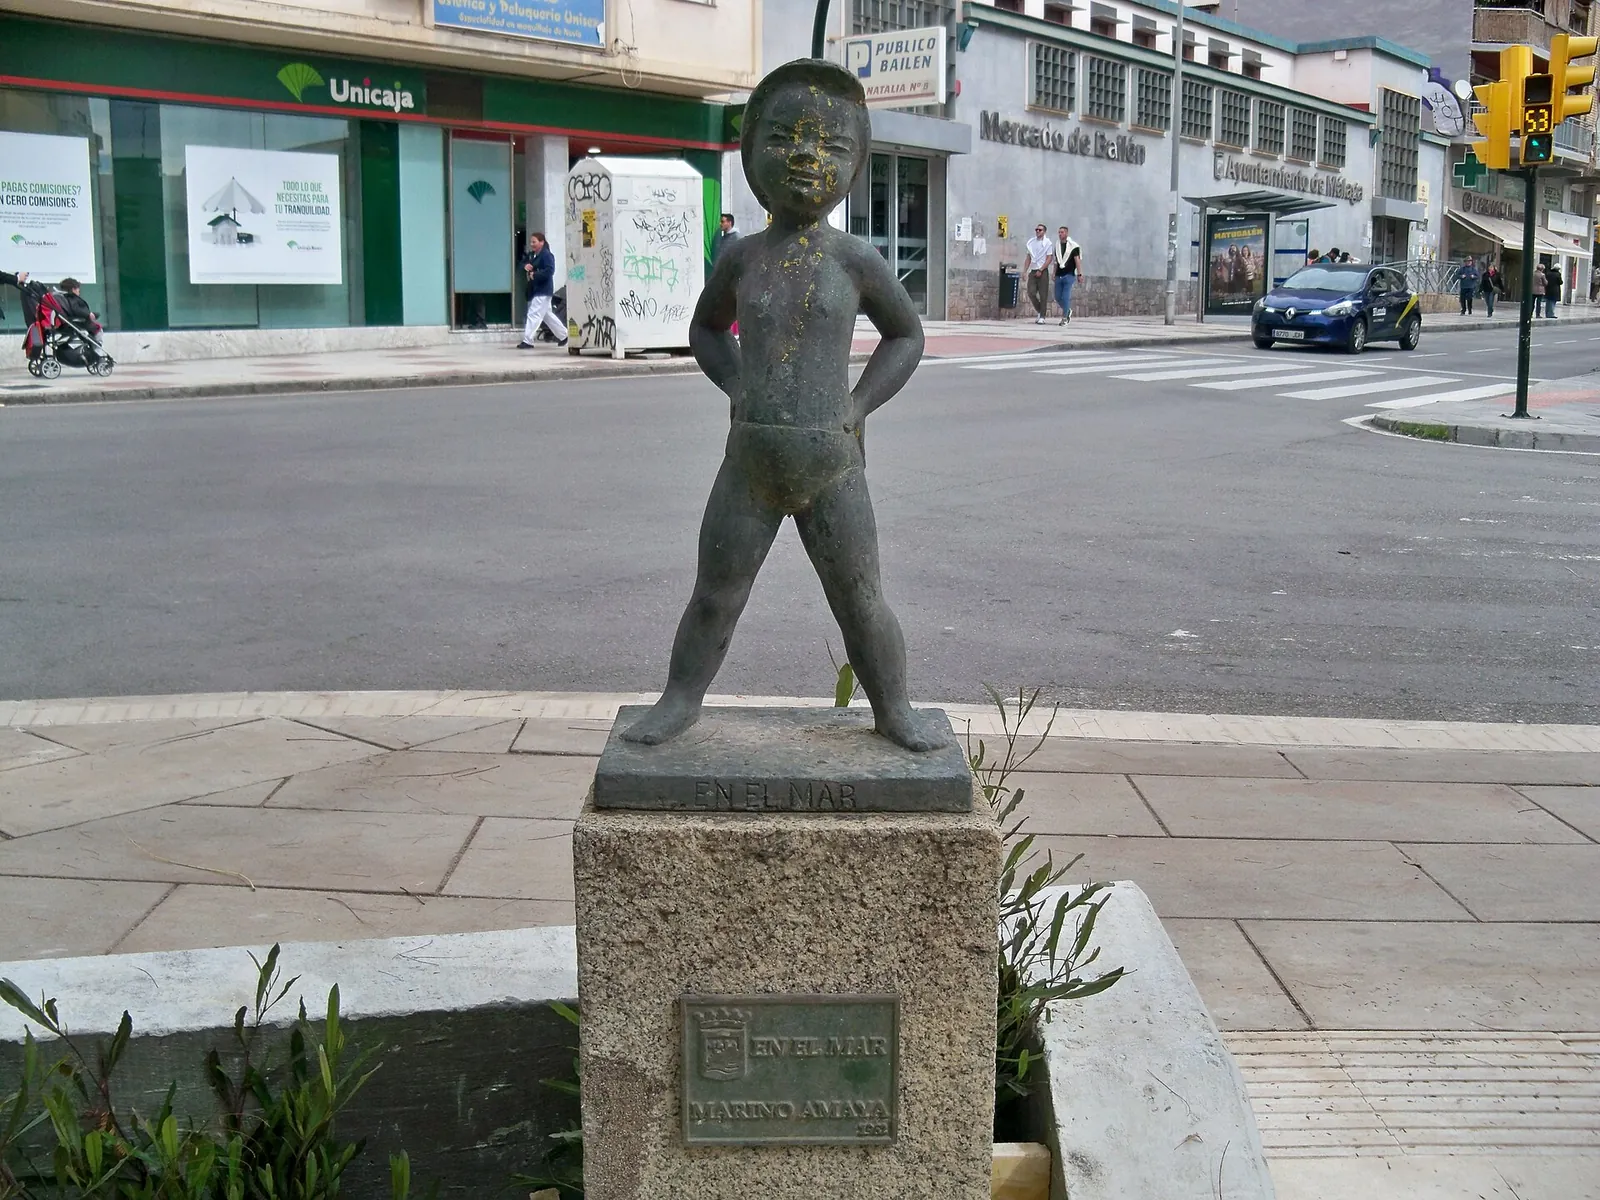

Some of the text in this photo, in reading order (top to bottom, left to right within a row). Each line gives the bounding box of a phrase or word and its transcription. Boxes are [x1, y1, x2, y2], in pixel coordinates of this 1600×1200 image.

[489, 3, 497, 15] y
[564, 9, 599, 27] Unisex
[506, 21, 515, 29] en
[554, 27, 562, 36] de
[875, 37, 936, 56] PUBLICO
[880, 55, 932, 72] BAILEN
[330, 76, 414, 113] Unicaja
[866, 83, 906, 96] NATALIA
[1525, 108, 1549, 132] 53
[980, 109, 1146, 165] Mercado de Bailén
[2, 181, 81, 195] PAGAS COMISIONES?
[283, 181, 322, 192] TODO LO QUE
[1225, 155, 1363, 205] Ayuntamiento de Málaga
[6, 195, 27, 206] CERO
[29, 196, 79, 208] COMISIONES.
[276, 192, 329, 204] NECESITAS PARA
[275, 204, 331, 216] TU TRANQUILIDAD.
[694, 779, 857, 809] EN EL MAR
[751, 1035, 889, 1057] EN EL MAR
[689, 1100, 890, 1120] MARINO AMAYA
